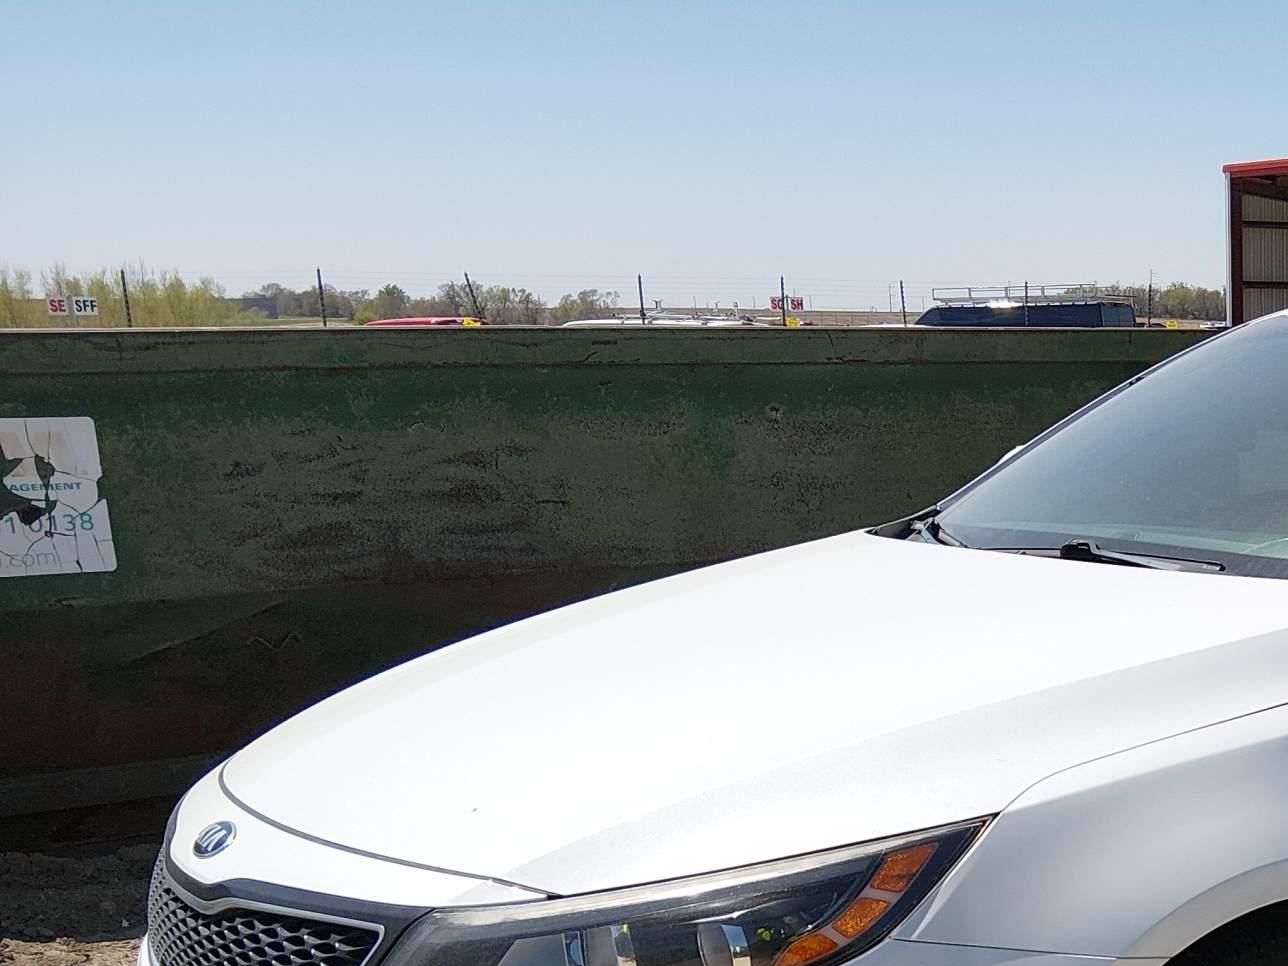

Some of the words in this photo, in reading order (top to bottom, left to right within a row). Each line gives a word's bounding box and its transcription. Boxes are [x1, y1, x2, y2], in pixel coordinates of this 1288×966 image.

[49, 299, 66, 312] SE
[74, 299, 97, 313] SFF
[790, 299, 804, 310] SH
